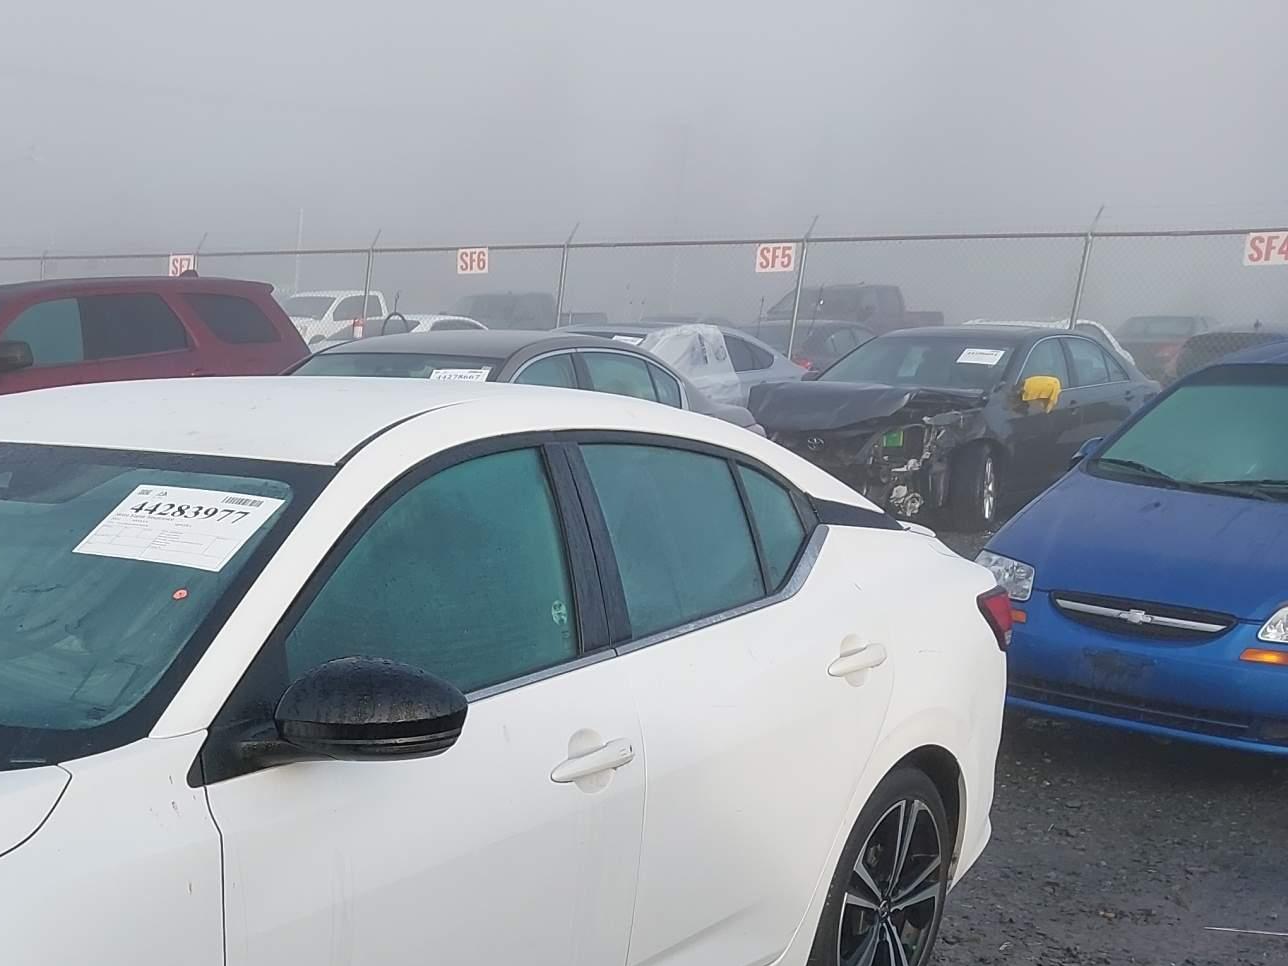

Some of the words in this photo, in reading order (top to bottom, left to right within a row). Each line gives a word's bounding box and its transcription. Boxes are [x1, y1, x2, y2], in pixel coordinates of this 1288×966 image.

[759, 245, 792, 269] SF5
[1248, 235, 1288, 262] SF4
[171, 257, 191, 276] SF7
[459, 250, 486, 272] SF6
[130, 501, 250, 525] 44283977
